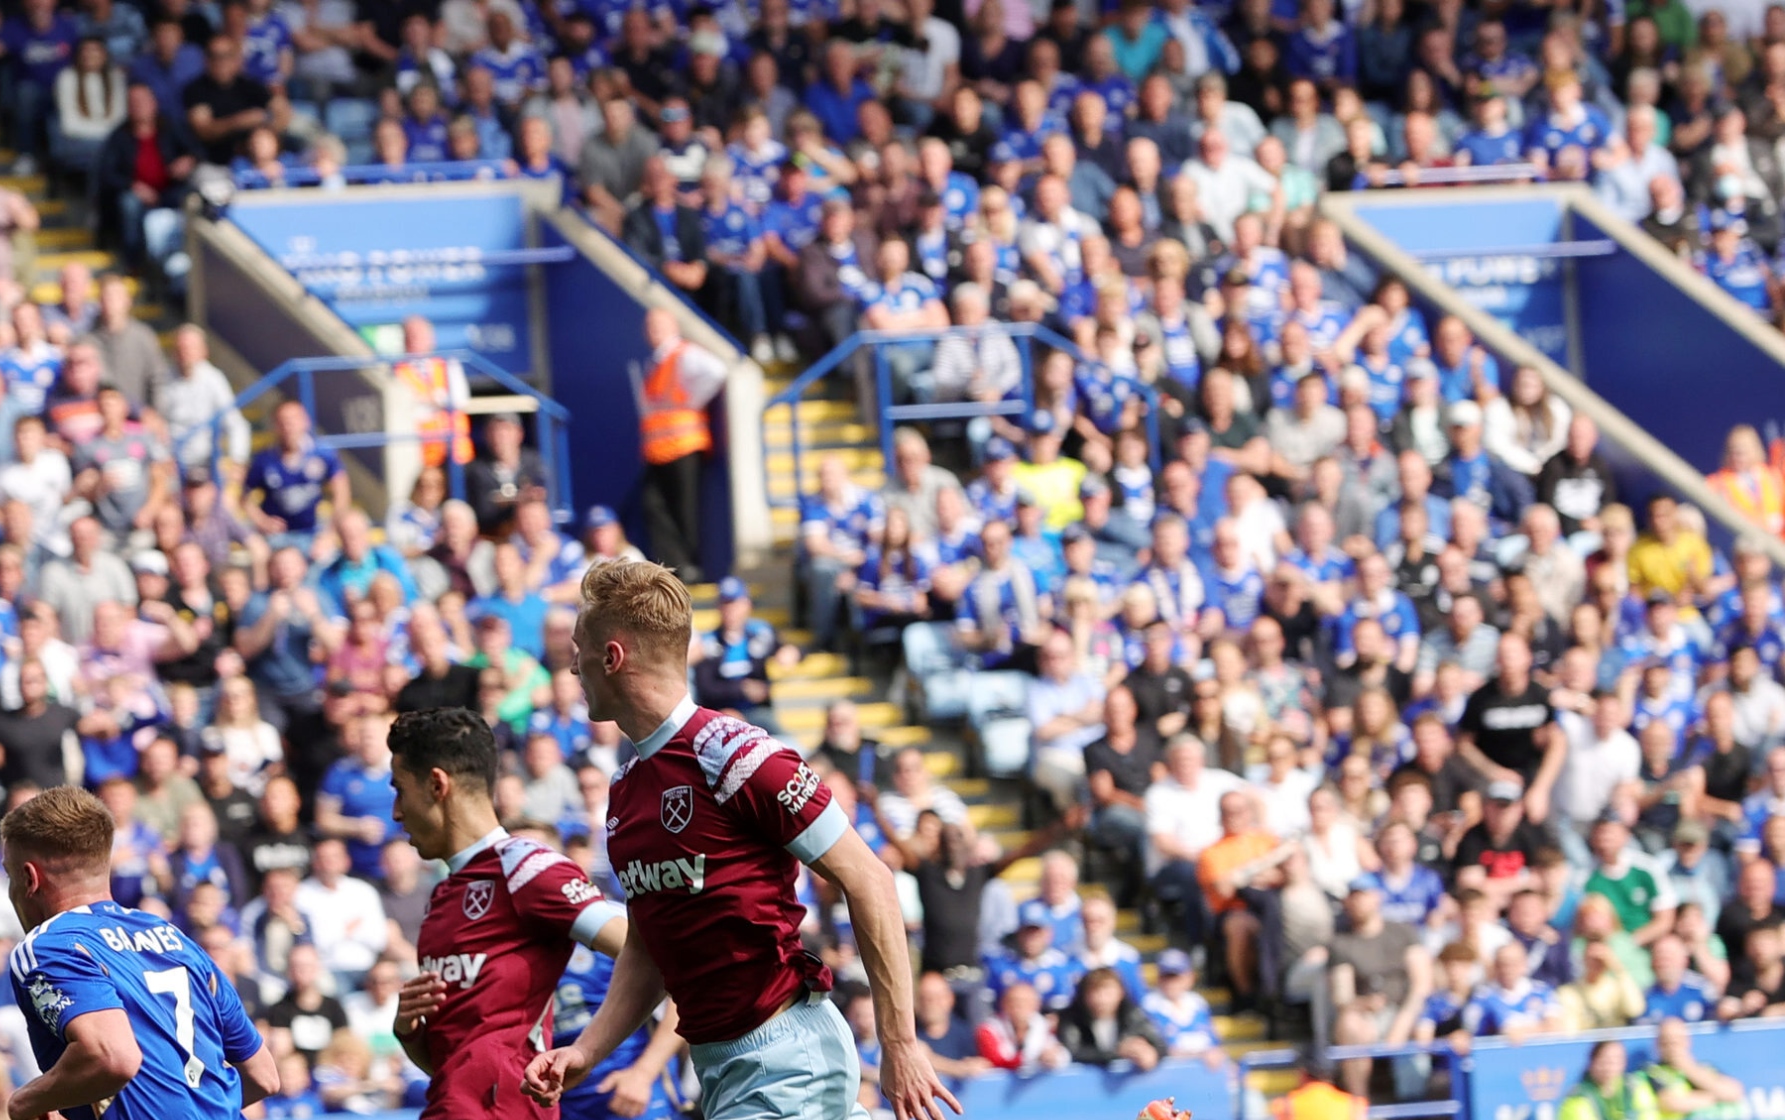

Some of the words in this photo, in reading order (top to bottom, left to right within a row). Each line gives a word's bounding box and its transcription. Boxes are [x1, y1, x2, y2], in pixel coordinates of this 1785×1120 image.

[618, 853, 706, 900] etway
[99, 925, 184, 955] BANES
[143, 966, 206, 1088] 7
